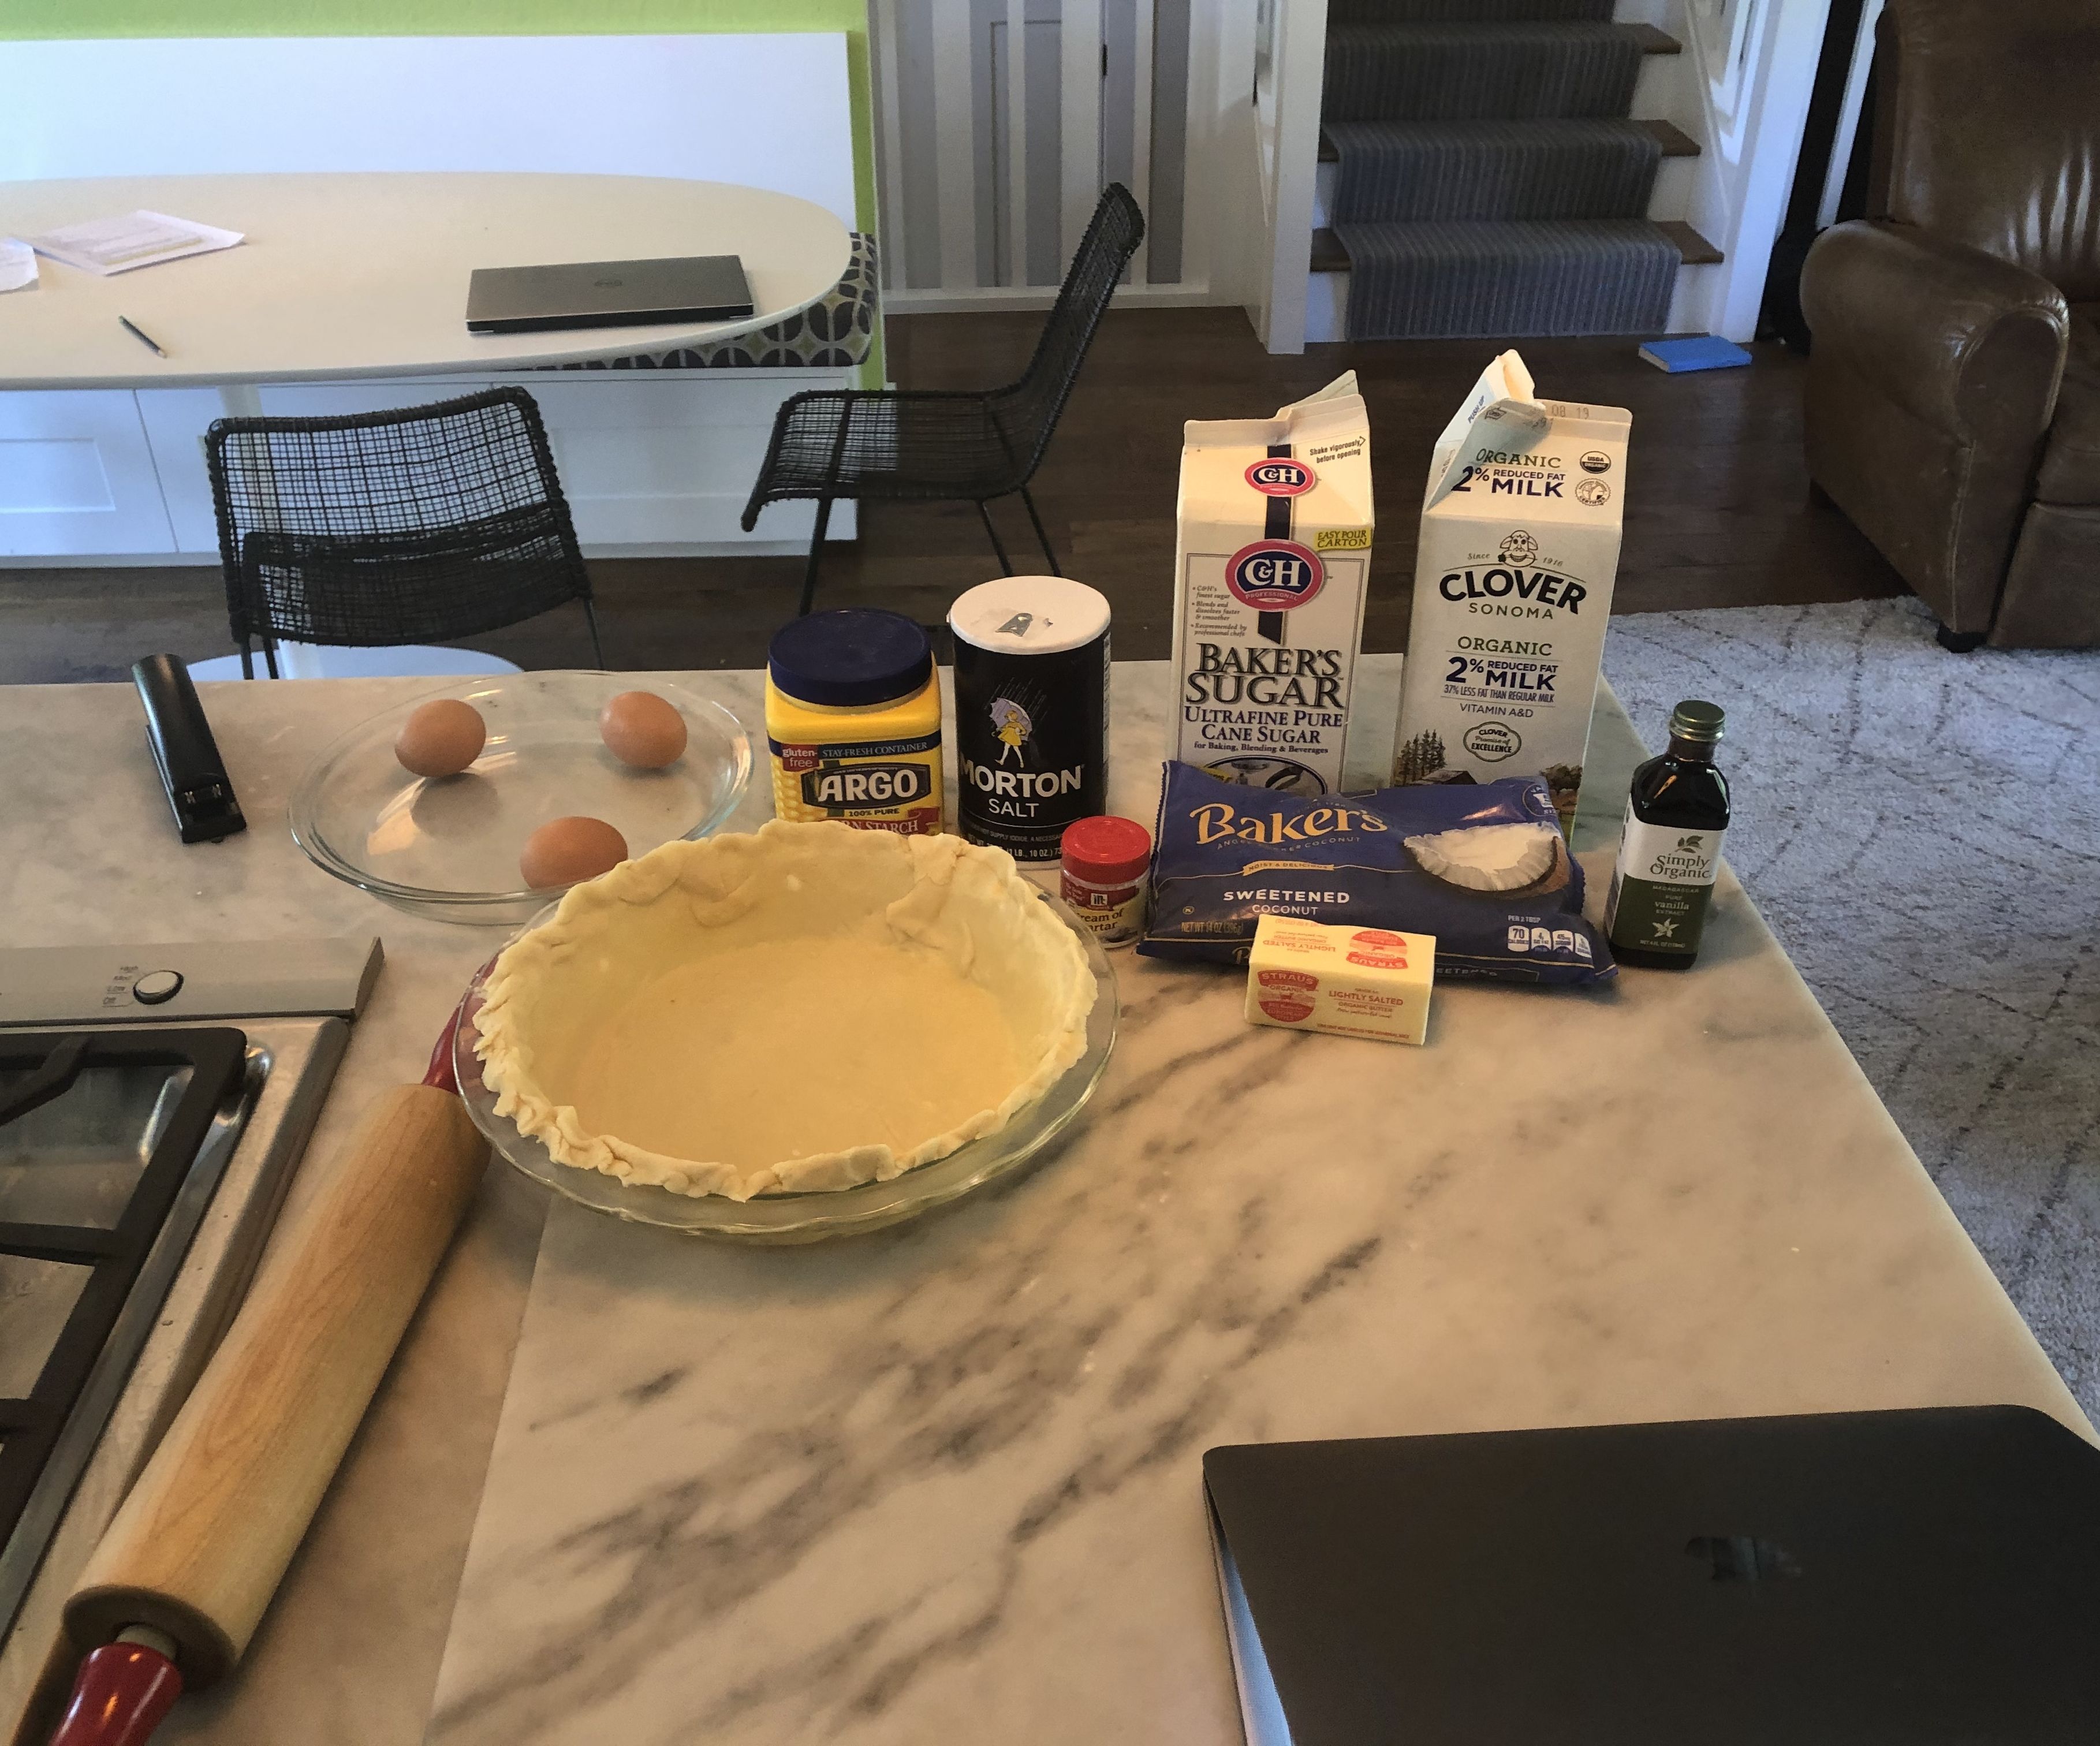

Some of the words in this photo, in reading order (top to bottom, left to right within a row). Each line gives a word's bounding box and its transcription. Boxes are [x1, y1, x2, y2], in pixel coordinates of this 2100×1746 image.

[1468, 407, 1479, 423] PUSH
[1480, 395, 1484, 406] UP
[1310, 446, 1328, 456] Shake
[1330, 439, 1360, 452] vigorously
[1316, 454, 1335, 463] before
[1337, 449, 1361, 460] opening
[1476, 448, 1561, 469] ORGANIC
[1258, 468, 1299, 483] C&H
[1451, 466, 1489, 492] 2%
[1493, 469, 1544, 480] REDUCED
[1547, 472, 1566, 481] FAT
[1491, 478, 1564, 498] MILK
[1318, 531, 1341, 540] EASY
[1342, 530, 1367, 539] POUR
[1317, 538, 1367, 548] CARTON
[1245, 558, 1304, 587] C&H
[1245, 591, 1297, 601] PROFESSIONAL
[1439, 569, 1587, 615] CLOVER
[1469, 602, 1553, 620] SONOMA
[1457, 636, 1552, 656] ORGANIC
[1195, 643, 1342, 677] BAKER'S
[1446, 656, 1484, 683] 2%
[1487, 660, 1537, 671] REDUCED
[1539, 664, 1558, 673] FAT
[1485, 670, 1557, 691] MILK
[1186, 672, 1344, 708] SUGAR
[1444, 684, 1459, 695] 37%
[1460, 686, 1476, 696] LESS
[1478, 688, 1489, 697] FAT
[1490, 689, 1507, 699] THAN
[1508, 691, 1536, 702] REGULAR
[1538, 693, 1555, 703] MILK
[1184, 706, 1288, 726] ULTRAFINE
[1293, 710, 1343, 727] PURE
[1460, 703, 1506, 715] VITAMIN
[1508, 708, 1534, 718] A&D
[1202, 723, 1252, 741] CANE
[1257, 726, 1321, 744] SUGAR
[1479, 729, 1508, 737] CLOVER
[782, 748, 818, 758] gluten-
[822, 747, 874, 758] STAY-FRESH
[875, 741, 928, 755] CONTAINER
[1194, 741, 1206, 749] for
[1208, 742, 1239, 751] Baking,
[1241, 743, 1277, 753] Blending
[1289, 745, 1329, 754] Beverages
[1471, 743, 1512, 753] EXCELLENCE
[789, 758, 813, 767] free
[960, 752, 1082, 797] MORTON
[818, 769, 918, 803] ARGO
[989, 798, 1039, 818] SALT
[866, 819, 919, 834] STARCH
[1189, 803, 1387, 845] Baker's
[990, 830, 1008, 840] SUPPLY
[1304, 836, 1361, 849] COCONUT
[1054, 847, 1062, 855] 73
[1657, 853, 1711, 868] Simply
[1650, 863, 1710, 879] Organic
[1223, 889, 1351, 904] SWEETENED
[1252, 904, 1319, 916] COCONUT
[1655, 901, 1689, 910] vanilla
[1076, 912, 1110, 923] ream
[1111, 908, 1124, 919] of
[1089, 921, 1118, 932] artar
[1214, 921, 1223, 933] OZ
[1512, 928, 1525, 939] 70
[1299, 943, 1337, 952] LIGHTLY
[1350, 956, 1404, 968] STRAUS
[1262, 972, 1314, 984] STRAUS
[1328, 990, 1367, 1001] LIGHTLY
[1368, 995, 1404, 1006] SALTED
[1338, 1001, 1368, 1009] ORGANIC
